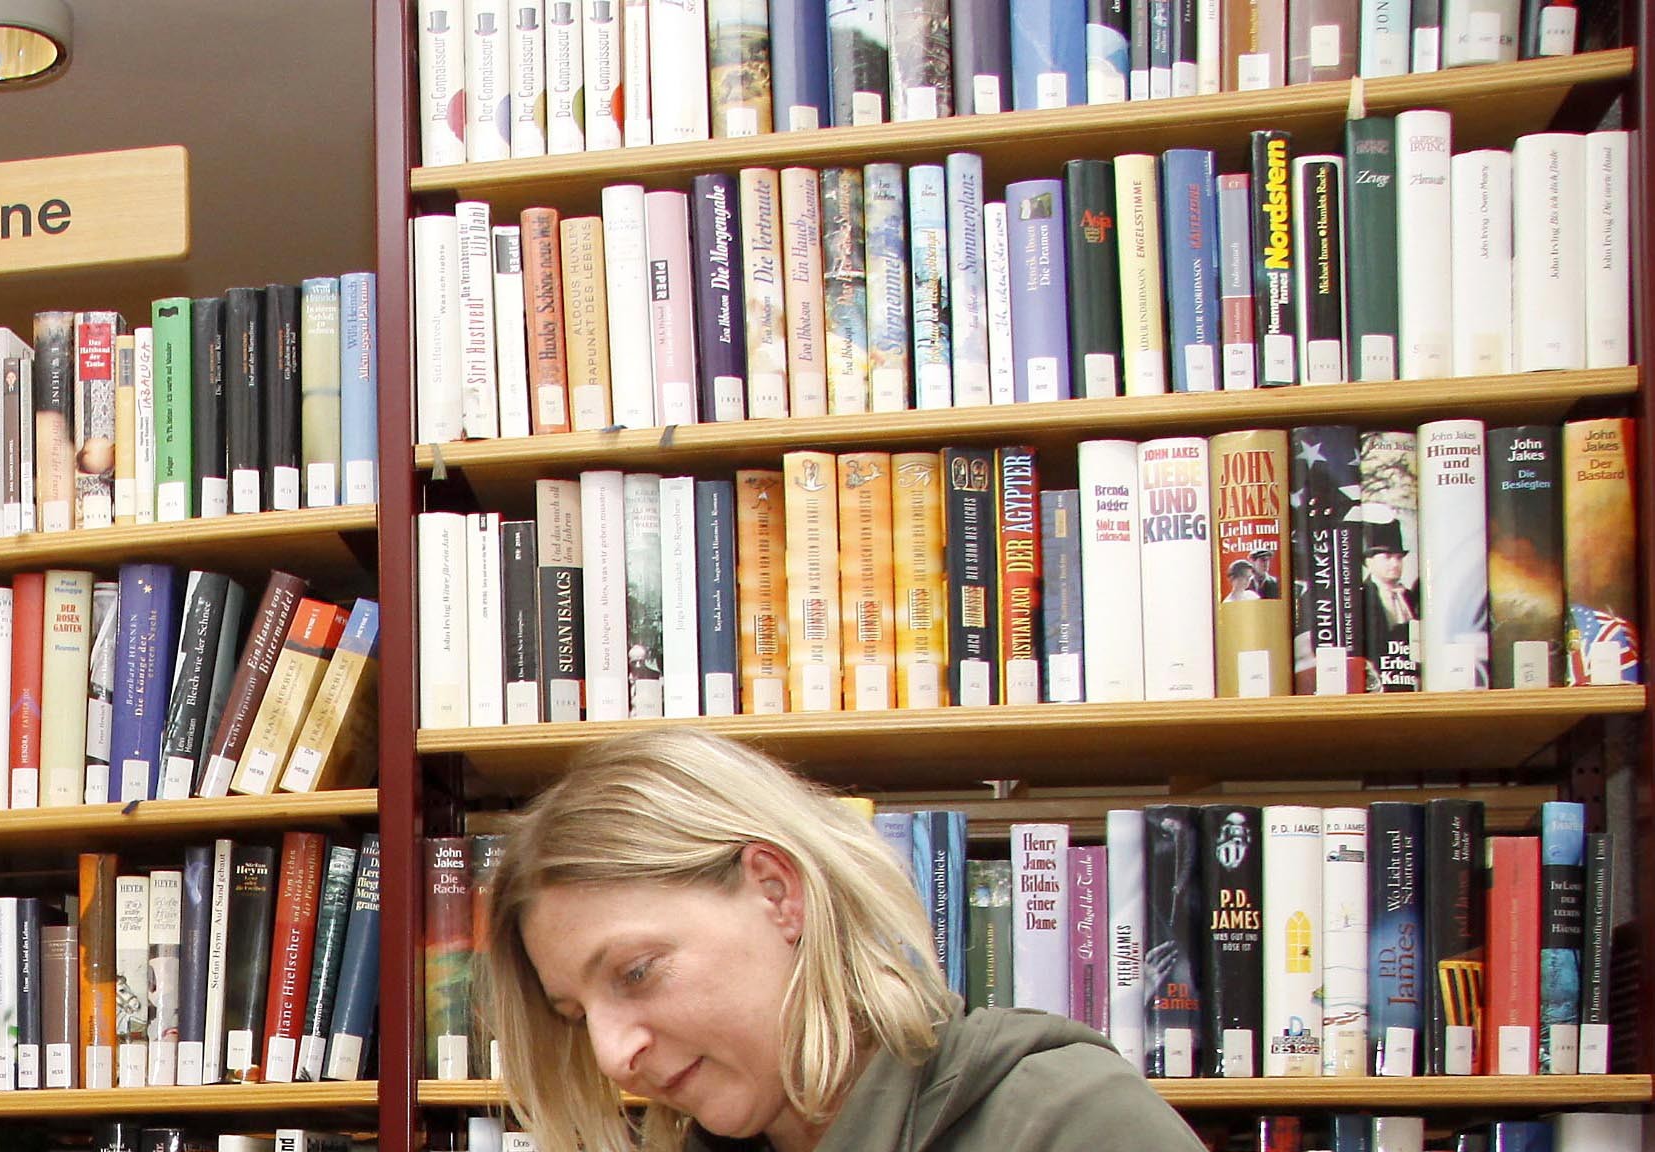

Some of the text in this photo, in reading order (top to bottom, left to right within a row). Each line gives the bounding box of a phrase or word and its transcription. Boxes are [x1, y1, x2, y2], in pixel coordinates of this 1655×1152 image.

[1266, 139, 1290, 269] Nordstern
[711, 183, 730, 292] Die Morgengabe
[1279, 272, 1289, 305] Innes
[1269, 272, 1279, 335] Hammond
[1584, 429, 1616, 443] John
[1426, 445, 1482, 459] Himmel
[1510, 438, 1542, 452] John
[1581, 440, 1619, 453] Jakes
[1443, 458, 1470, 471] und
[1508, 450, 1545, 463] Jakes
[1589, 458, 1613, 470] Der
[1220, 451, 1276, 486] JOHN
[1517, 469, 1536, 480] Die
[1577, 469, 1626, 482] Bastard
[1437, 472, 1476, 486] Hölle
[1502, 480, 1552, 491] Besiegten
[1094, 485, 1129, 498] Brenda
[1097, 499, 1128, 513] Jagger
[1150, 487, 1197, 515] UND
[1219, 486, 1280, 520] JAKES
[1003, 453, 1031, 574] DER ÄGYPTER
[1143, 515, 1207, 544] KRIEG
[1219, 521, 1279, 538] Licht und
[1222, 536, 1278, 552] Schatten
[55, 613, 80, 624] ROSEN
[558, 571, 574, 673] SUSAN ISAACS
[1388, 641, 1410, 656] Die
[1023, 832, 1057, 853] Henry
[435, 847, 462, 859] John
[433, 858, 465, 869] Jakes
[1023, 853, 1057, 871] James
[1388, 829, 1400, 912] Wo Licht und
[440, 874, 458, 884] Die
[1021, 874, 1060, 894] Bildnis
[433, 884, 466, 895] Rache
[1026, 898, 1056, 910] einer
[1221, 890, 1252, 909] P.D.
[211, 853, 227, 990] Stefan Heym Auf Sand gebaut
[1026, 912, 1057, 931] Dame
[1211, 910, 1260, 930] JAMES
[1388, 922, 1418, 1005] James
